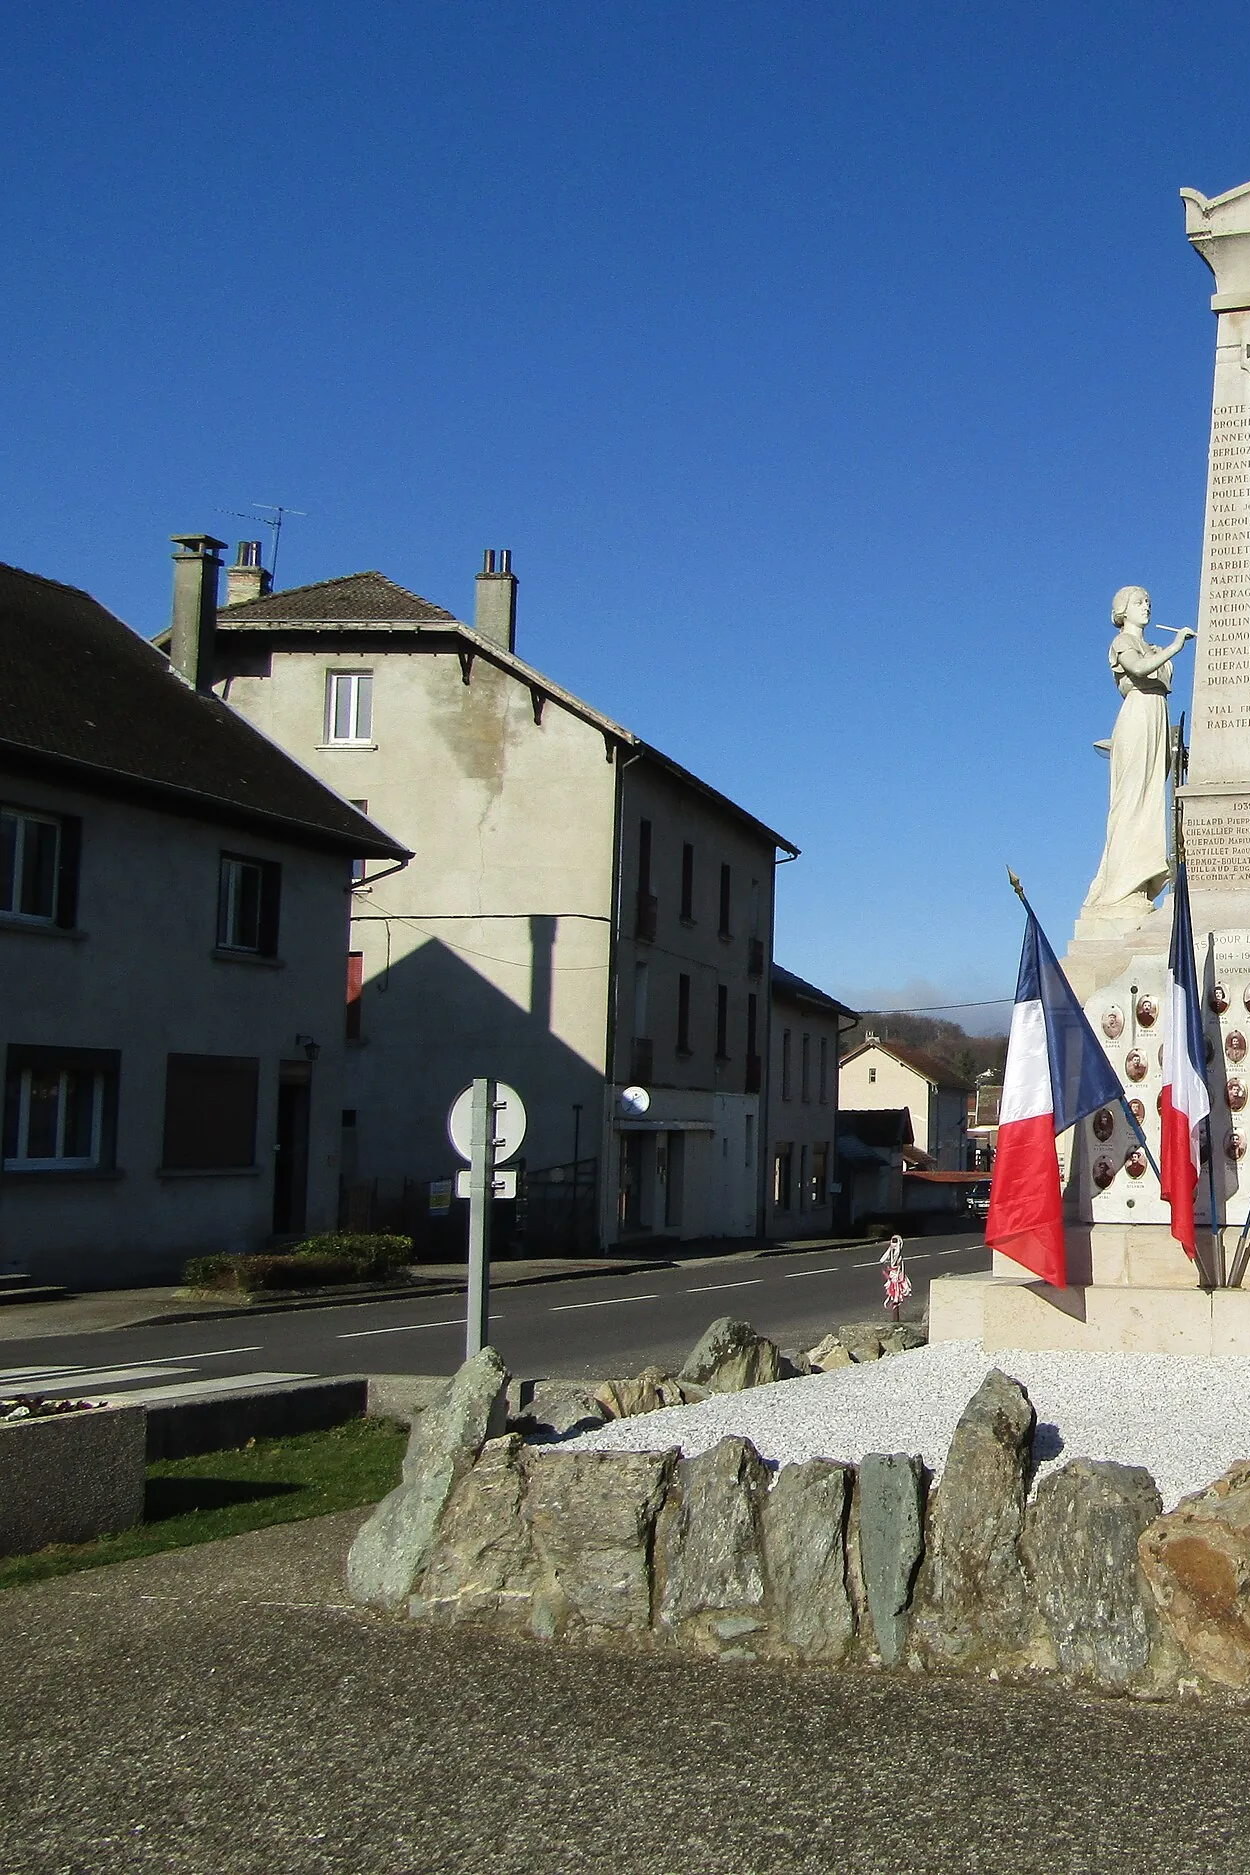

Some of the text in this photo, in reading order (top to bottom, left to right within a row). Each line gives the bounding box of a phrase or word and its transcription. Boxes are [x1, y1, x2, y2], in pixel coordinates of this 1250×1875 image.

[1212, 488, 1250, 499] POULET
[1212, 504, 1236, 512] VIAL
[1211, 546, 1250, 556] POULET
[1210, 574, 1250, 585] MARTIN
[1209, 618, 1250, 628] MOULIN
[1208, 705, 1233, 714] VIAL
[1187, 848, 1228, 856] LANTILLET
